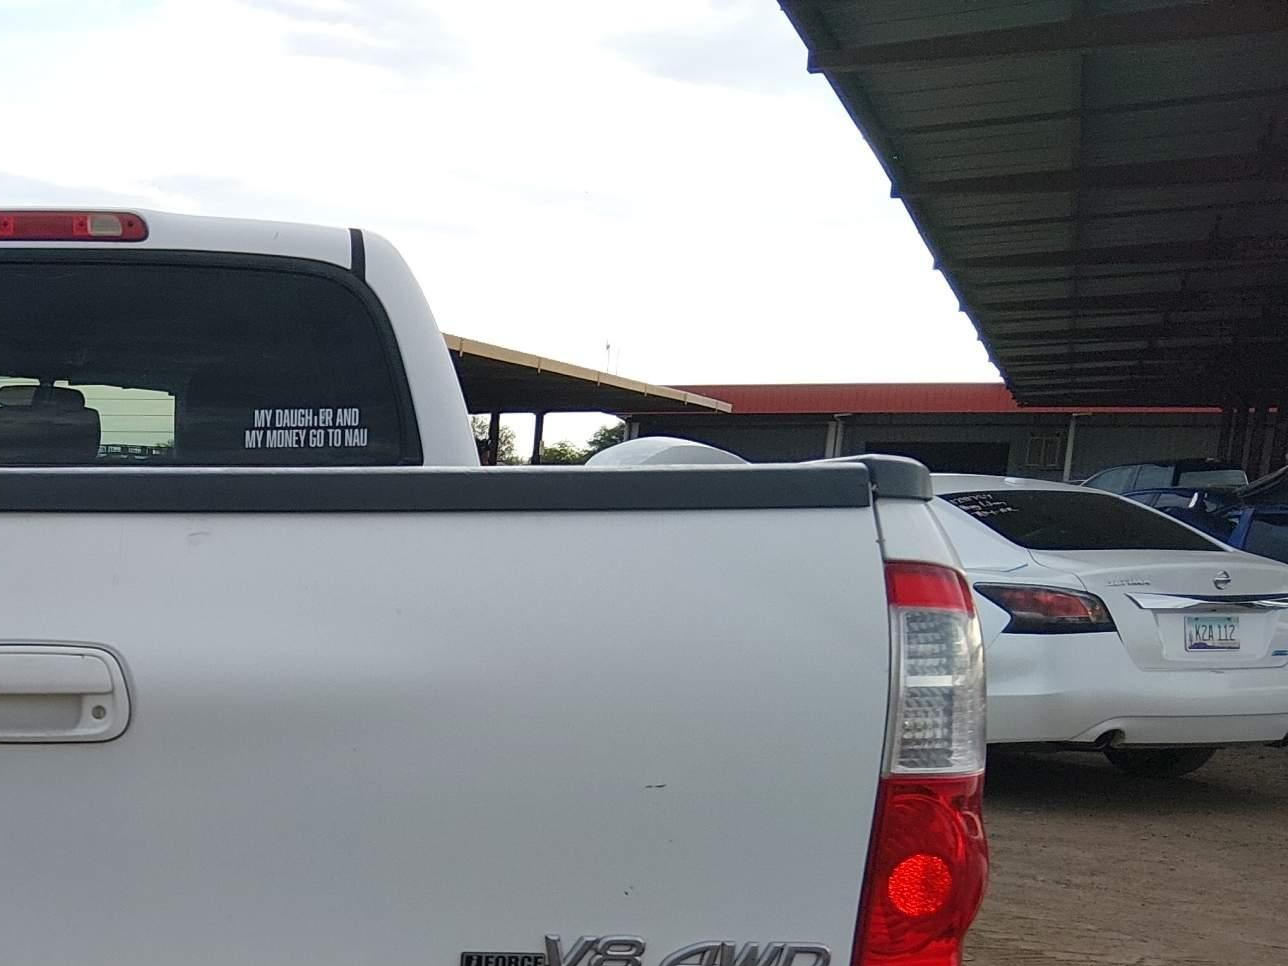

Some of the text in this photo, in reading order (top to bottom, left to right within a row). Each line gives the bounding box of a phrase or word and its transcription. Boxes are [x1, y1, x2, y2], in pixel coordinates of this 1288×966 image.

[254, 407, 360, 428] MY DAUGHER AND
[245, 428, 368, 448] MY MONEY GO TO NAU
